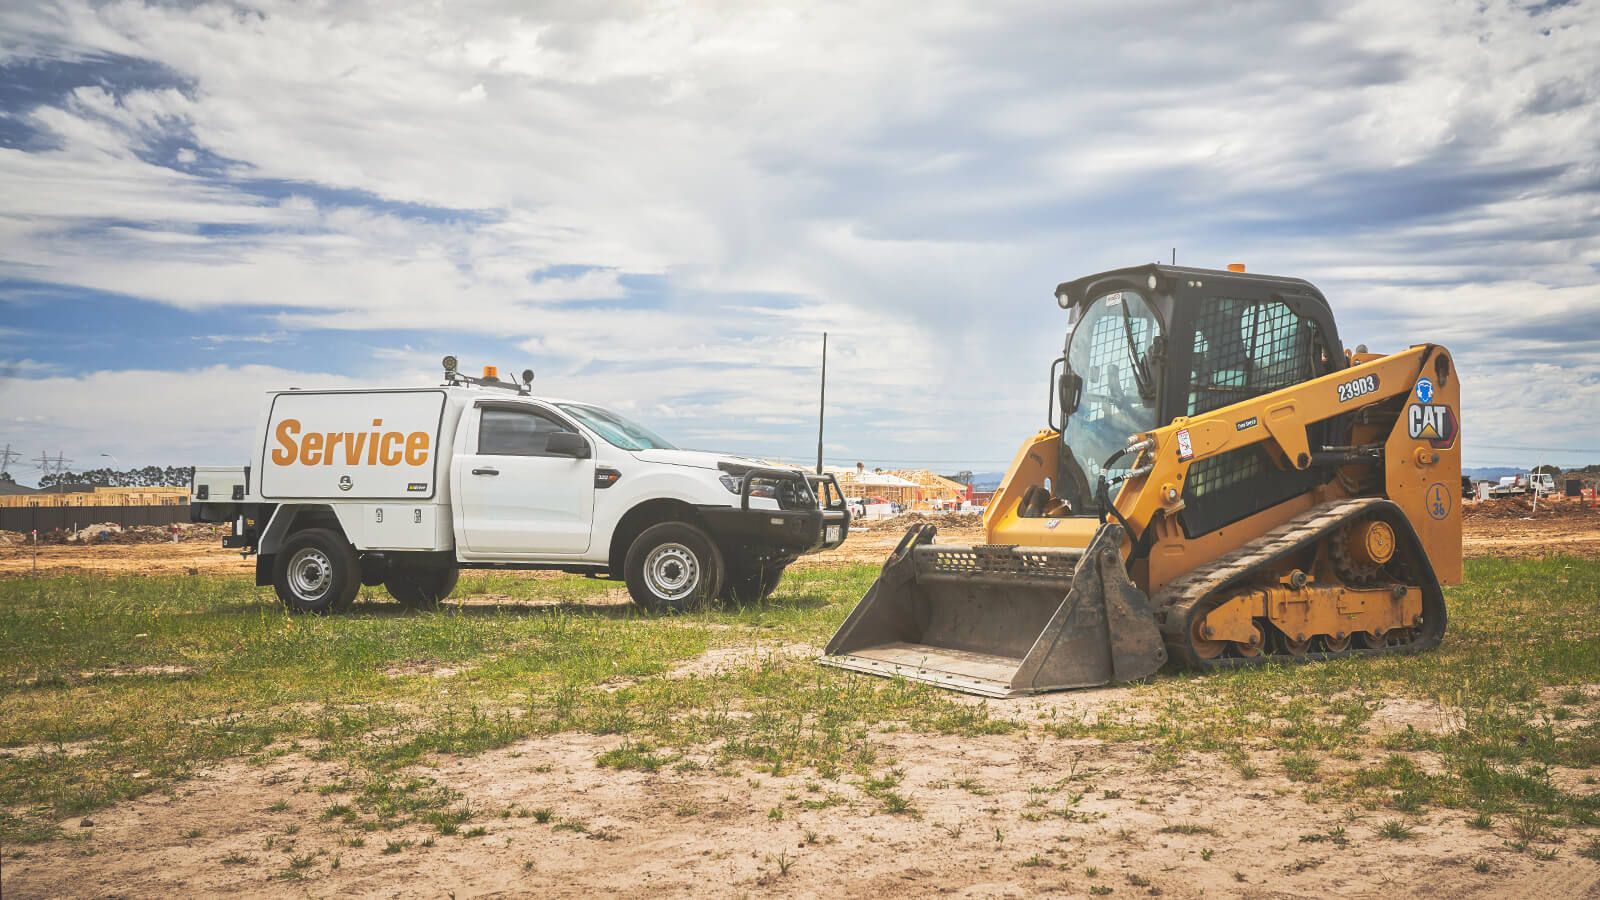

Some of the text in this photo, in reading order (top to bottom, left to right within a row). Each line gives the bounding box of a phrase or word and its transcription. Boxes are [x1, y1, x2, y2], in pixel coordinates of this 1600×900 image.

[1338, 375, 1375, 402] 239D3
[1408, 404, 1446, 439] CAT
[271, 418, 430, 467] Service
[1435, 487, 1441, 501] L
[1432, 502, 1446, 516] 36
